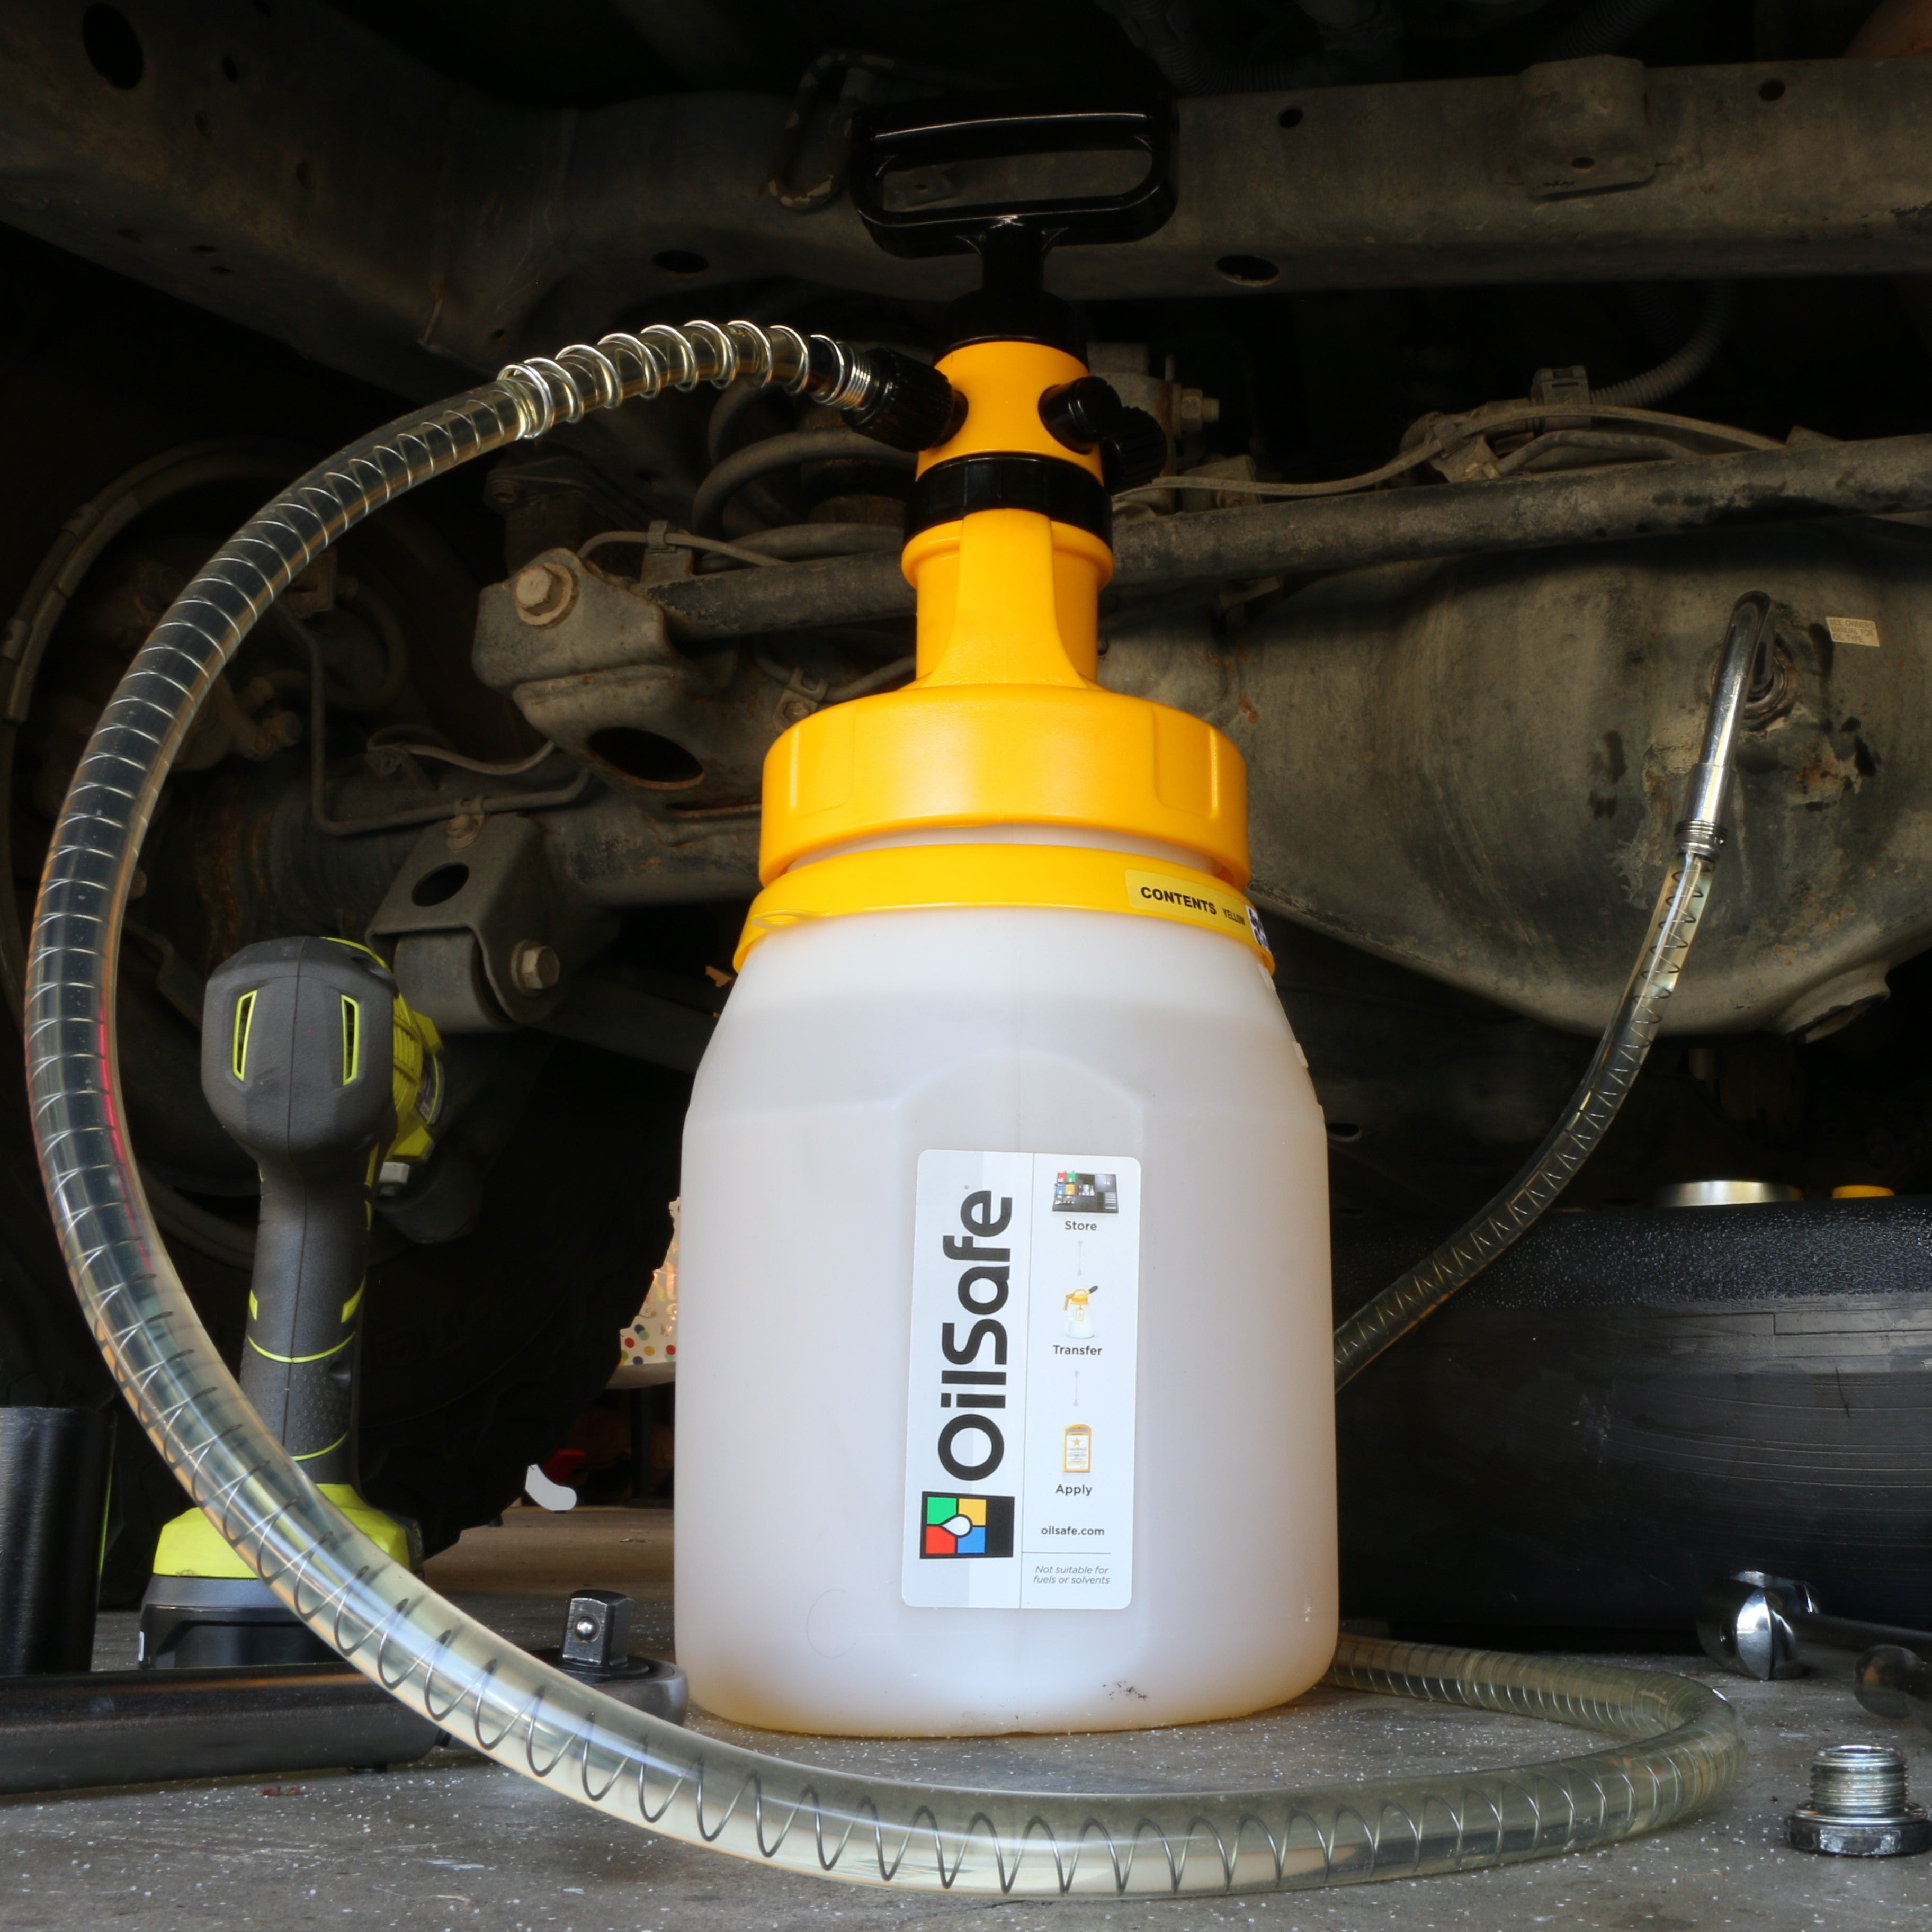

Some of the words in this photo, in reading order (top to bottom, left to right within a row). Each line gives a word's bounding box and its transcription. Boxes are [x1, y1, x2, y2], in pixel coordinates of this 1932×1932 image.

[1140, 887, 1217, 915] CONTENTS
[1222, 908, 1246, 926] YELLOW
[1065, 1221, 1097, 1231] Store
[938, 1189, 1012, 1481] OilSafe
[1053, 1345, 1102, 1355] Transfer
[1056, 1484, 1092, 1496] Apply
[1041, 1526, 1105, 1535] oilsafe.com
[1056, 1566, 1093, 1574] suitable
[1095, 1566, 1109, 1574] for
[1033, 1575, 1056, 1584] fuels
[1071, 1576, 1110, 1584] solvents
